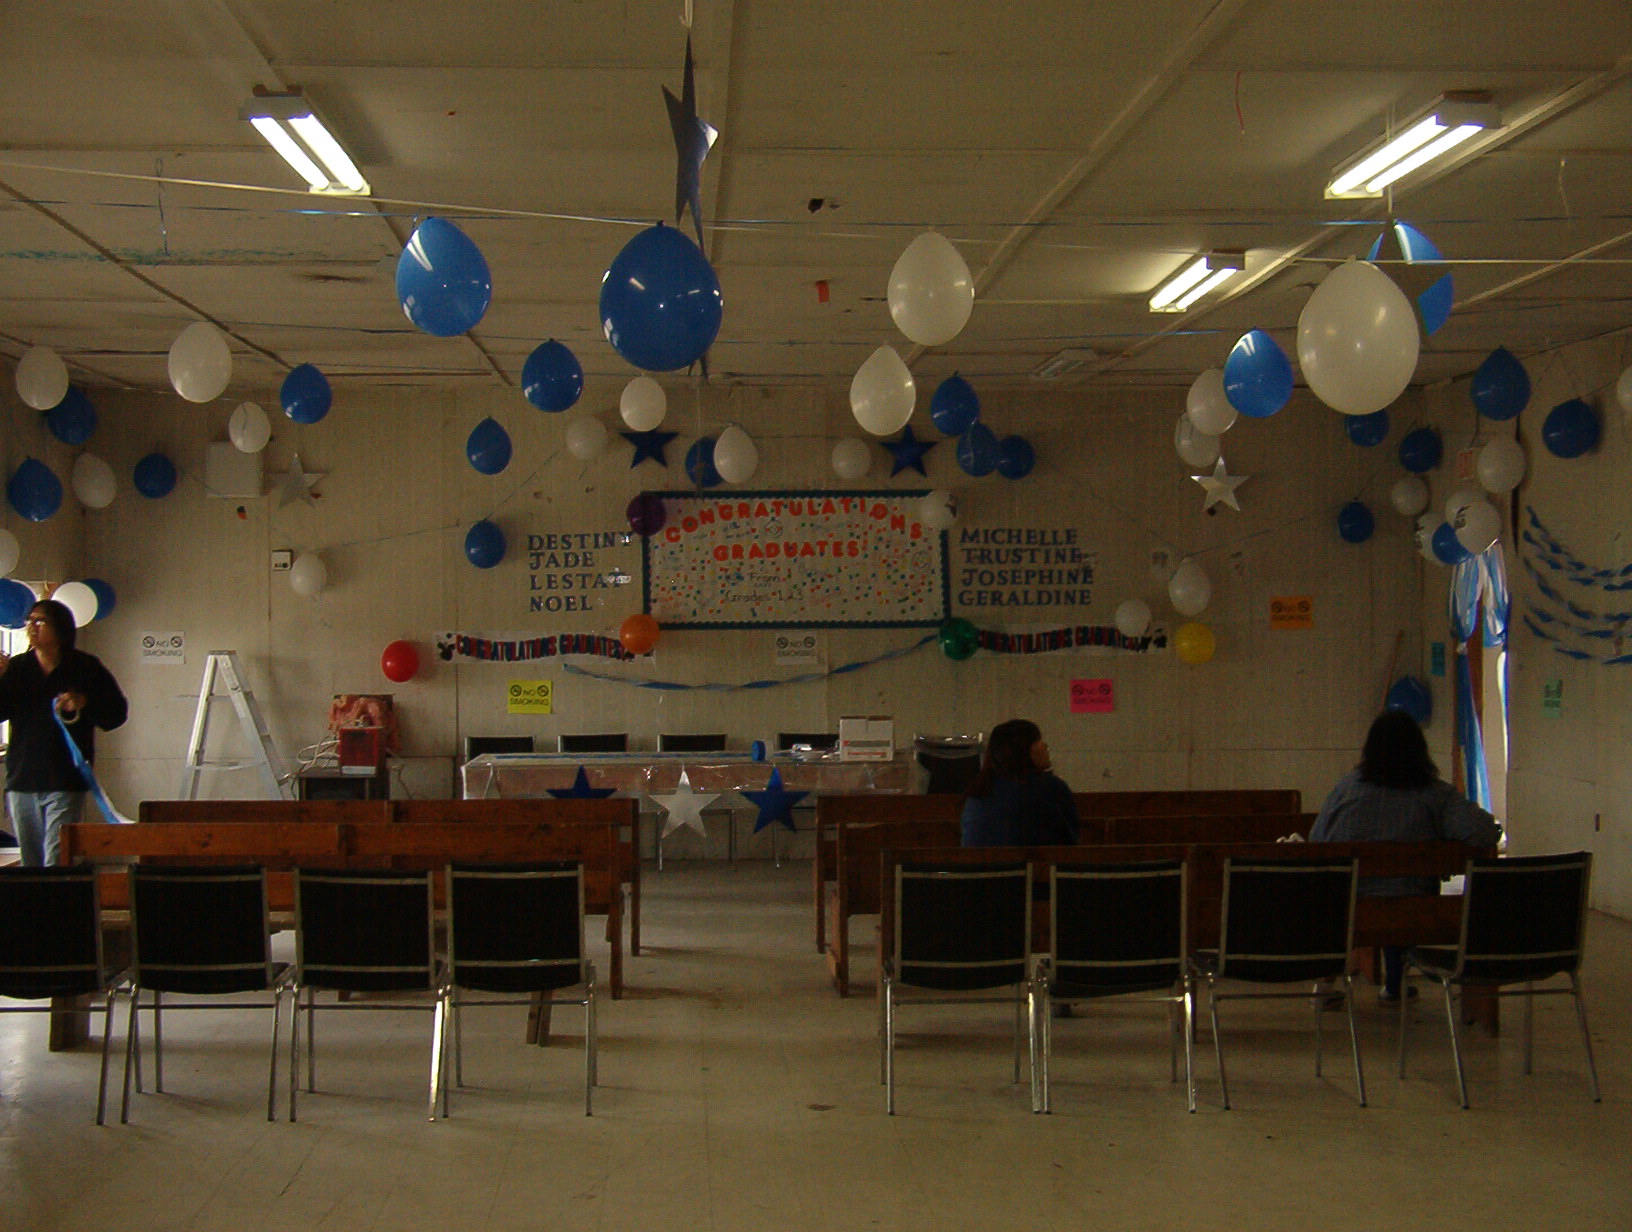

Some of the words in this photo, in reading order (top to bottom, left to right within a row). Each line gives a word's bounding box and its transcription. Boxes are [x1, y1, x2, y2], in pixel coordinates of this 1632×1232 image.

[665, 498, 922, 543] CONGRATULATIONS
[527, 531, 635, 550] DESTINY
[960, 527, 1077, 545] MICHELLE
[528, 551, 596, 570] JADE
[961, 547, 1083, 564] TRUSTINE
[961, 567, 1094, 586] JOSEPHINE
[529, 595, 593, 612] NOEL
[958, 589, 1092, 606] GERALDINE
[456, 634, 557, 661] CONGRATULATIONS
